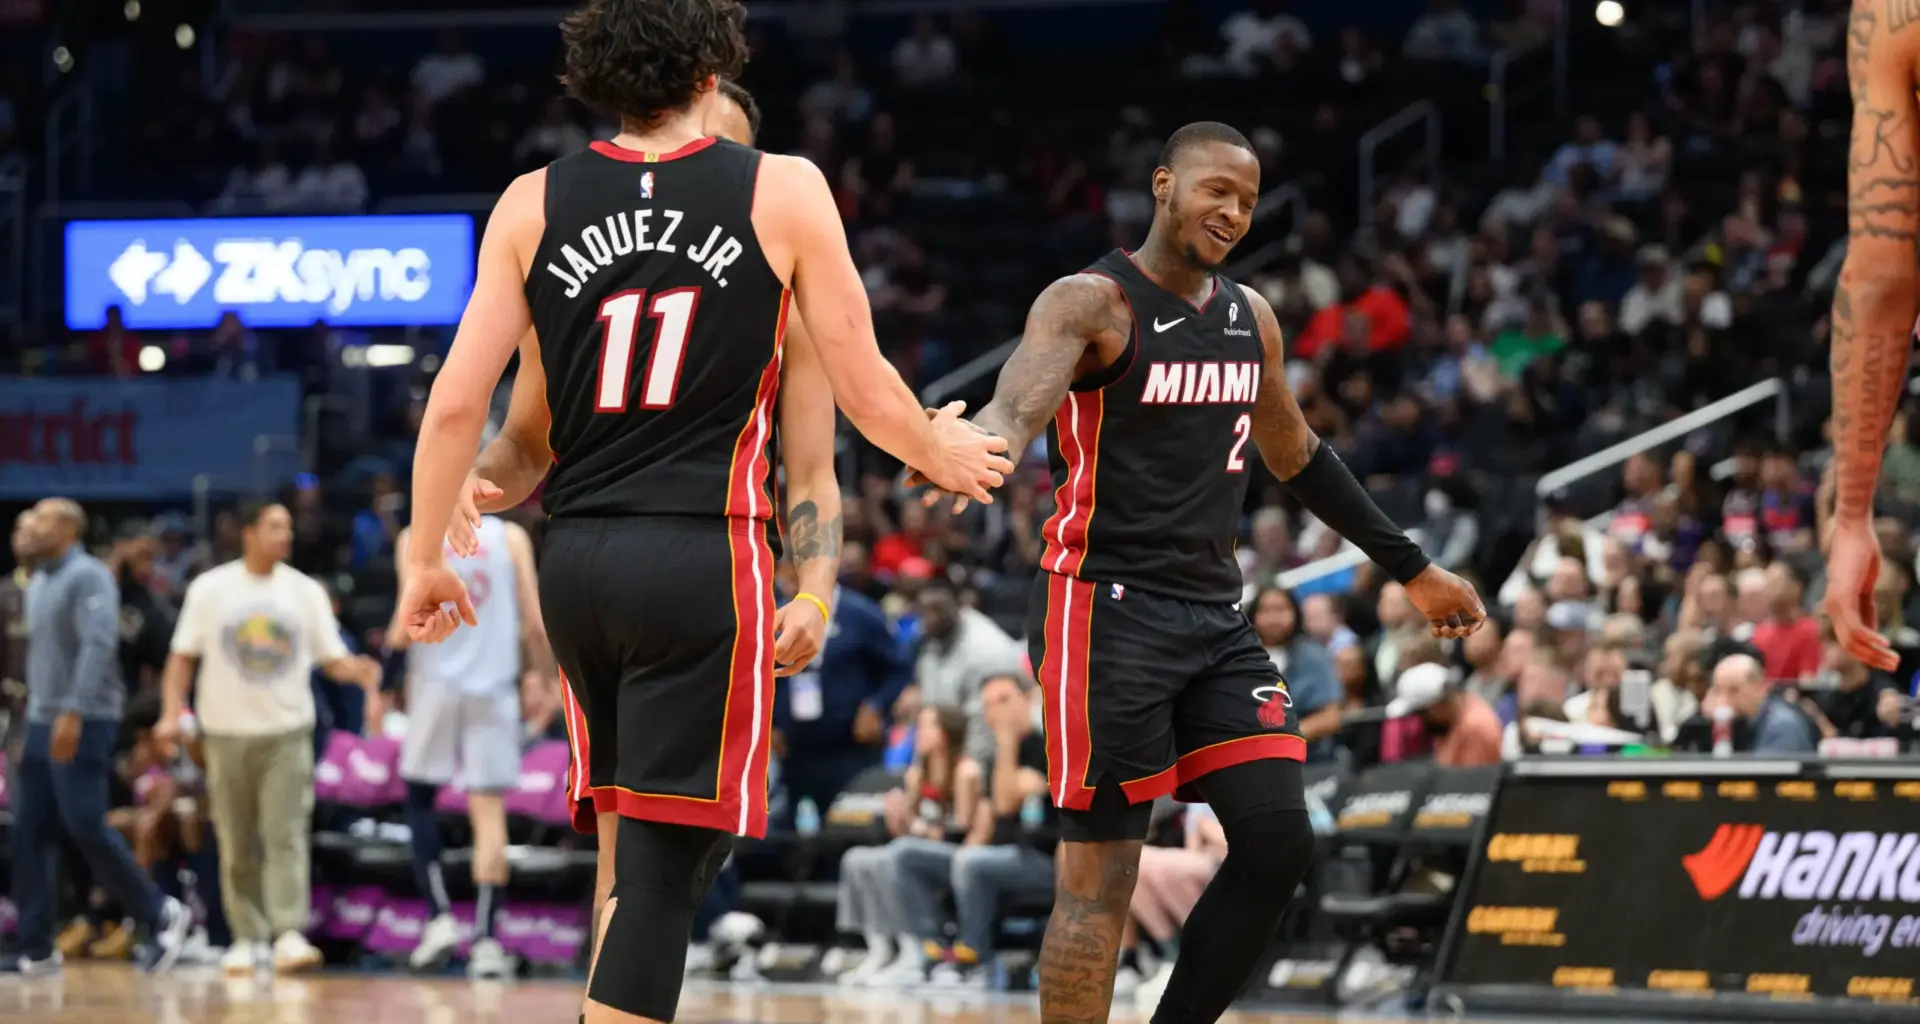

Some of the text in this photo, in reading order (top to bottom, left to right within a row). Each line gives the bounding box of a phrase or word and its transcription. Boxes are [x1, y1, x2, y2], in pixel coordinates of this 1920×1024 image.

[213, 237, 432, 316] ZKsync
[547, 209, 743, 299] JAQUEZ JR.
[593, 286, 702, 414] 11
[1139, 361, 1261, 405] MIAMI
[1225, 411, 1251, 473] 2
[1791, 903, 1893, 957] driving
